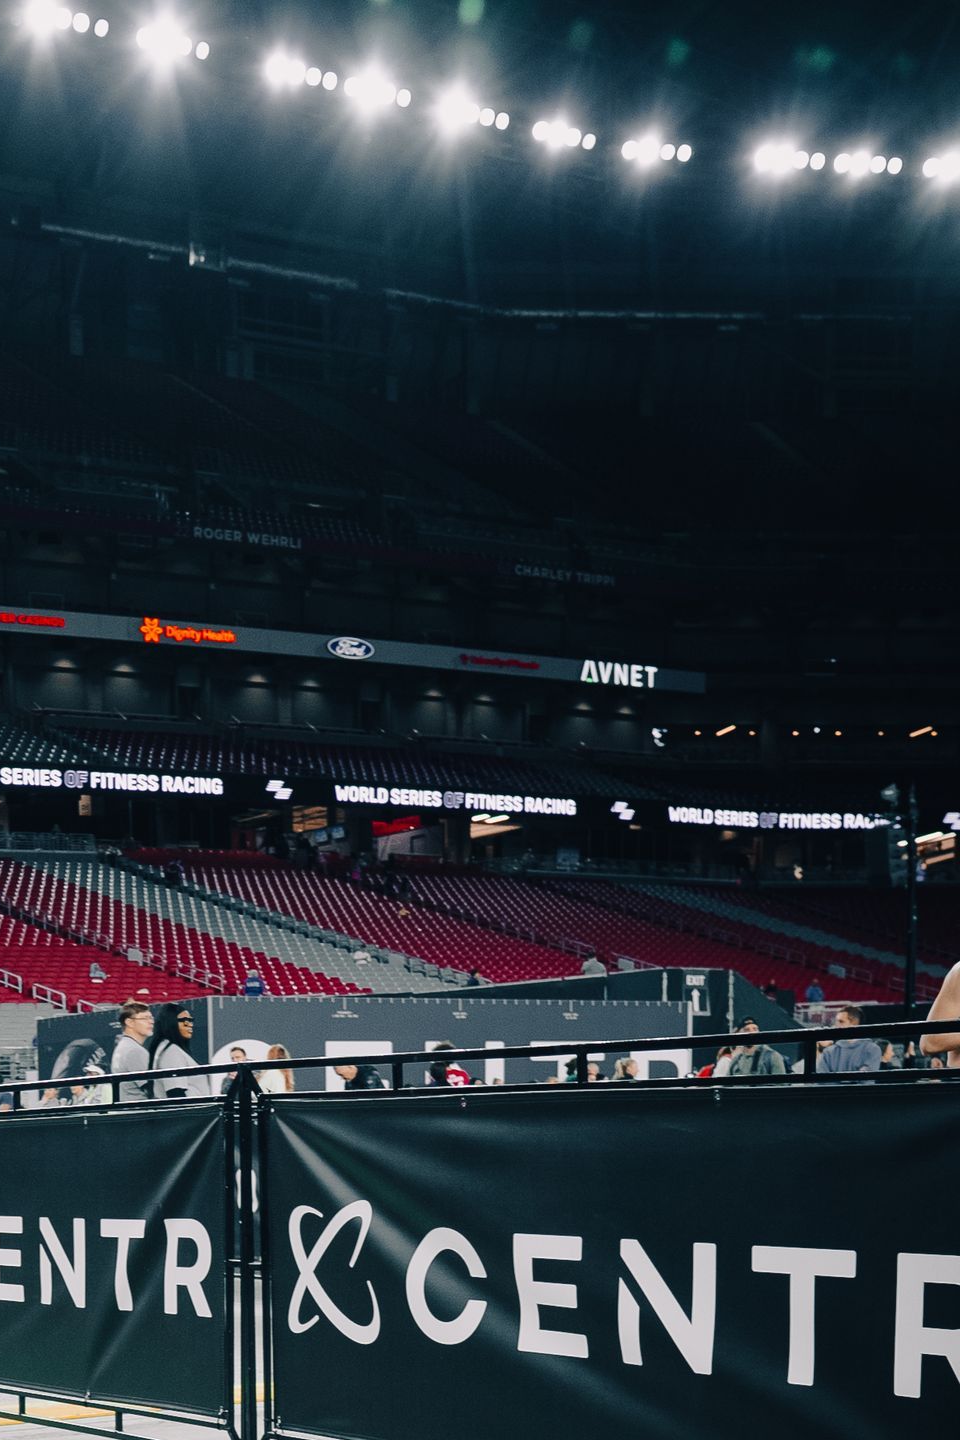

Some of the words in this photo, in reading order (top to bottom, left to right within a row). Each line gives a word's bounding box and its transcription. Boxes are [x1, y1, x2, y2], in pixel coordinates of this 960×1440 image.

[192, 526, 243, 543] ROGER
[245, 531, 304, 549] WEHRLI
[514, 563, 574, 582] CHARLEY
[165, 624, 202, 644] Dignity
[202, 627, 237, 643] Health
[580, 659, 658, 689] AVNET
[0, 766, 63, 788] SERIES
[63, 769, 88, 789] OF
[90, 771, 160, 792] FITNESS
[161, 775, 224, 796] RACING
[334, 784, 389, 804] WORLD
[389, 787, 443, 808] SERIES
[443, 790, 465, 809] OF
[465, 793, 524, 812] FITNESS
[524, 796, 577, 816] RACING
[668, 806, 713, 825] WORLD
[713, 809, 759, 828] SERIES
[779, 813, 842, 830] FITNESS
